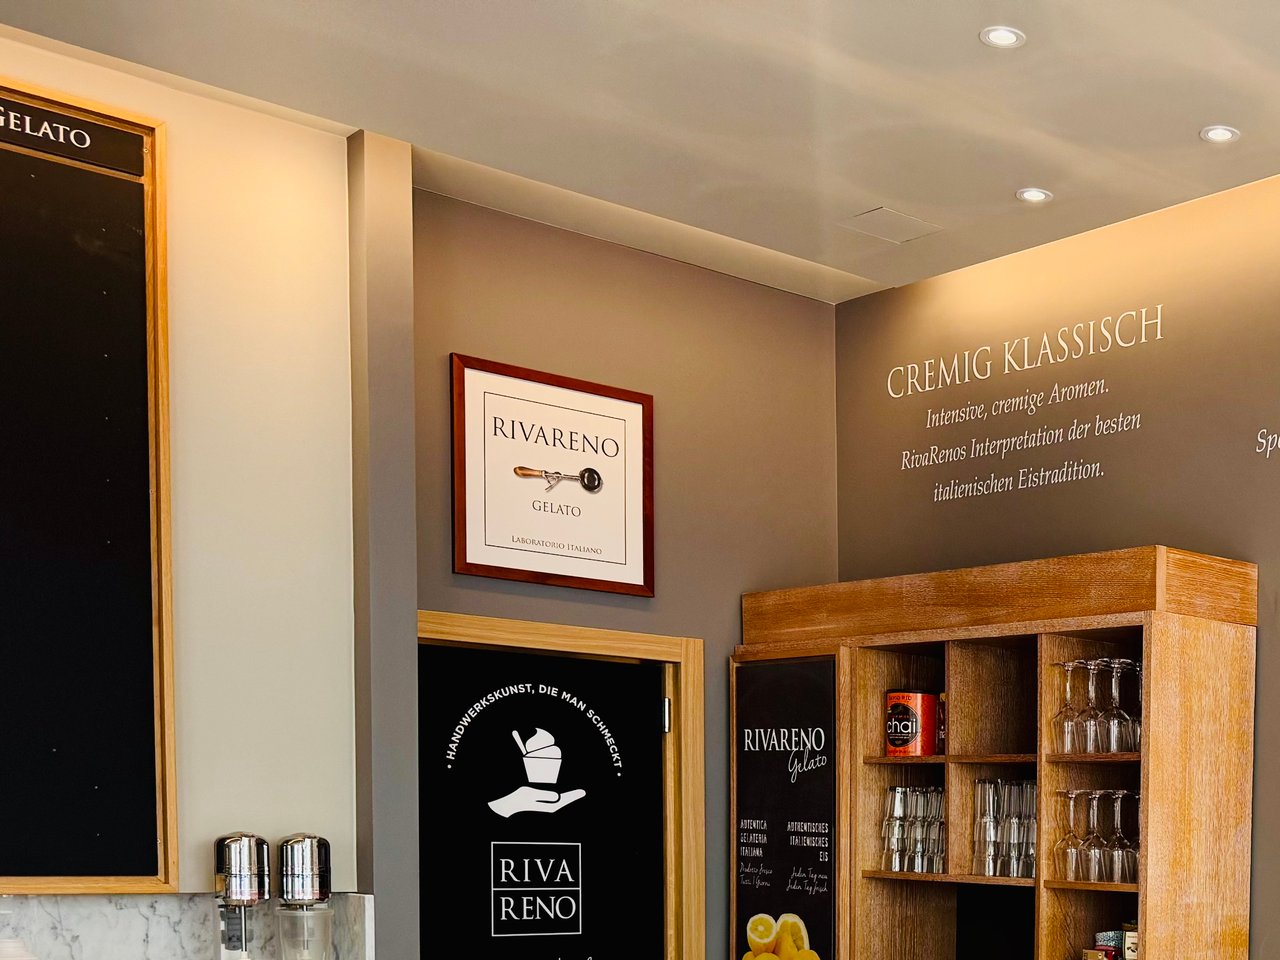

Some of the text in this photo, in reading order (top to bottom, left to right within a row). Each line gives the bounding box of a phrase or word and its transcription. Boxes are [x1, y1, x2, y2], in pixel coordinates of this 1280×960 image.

[0, 106, 91, 148] ELATO
[887, 304, 1164, 398] CREMIG KLASSISCH
[926, 378, 1109, 429] Intensive, cremige Aromen.
[493, 416, 619, 458] RIVARENO
[901, 412, 1142, 470] RivaRenos Interpretation der besten
[933, 460, 1104, 502] italienischen Eistradition.
[532, 500, 582, 517] GELATO
[511, 535, 603, 555] LABORATORIO ITALIANO
[446, 684, 623, 770] HANDWERKSKUNST, DIE MAN SCHMECKT
[744, 727, 825, 751] RIVARENO
[887, 718, 916, 733] chai
[788, 744, 828, 784] Gelato
[499, 858, 575, 883] RIVA
[819, 851, 829, 862] EIS
[499, 895, 576, 921] RENO
